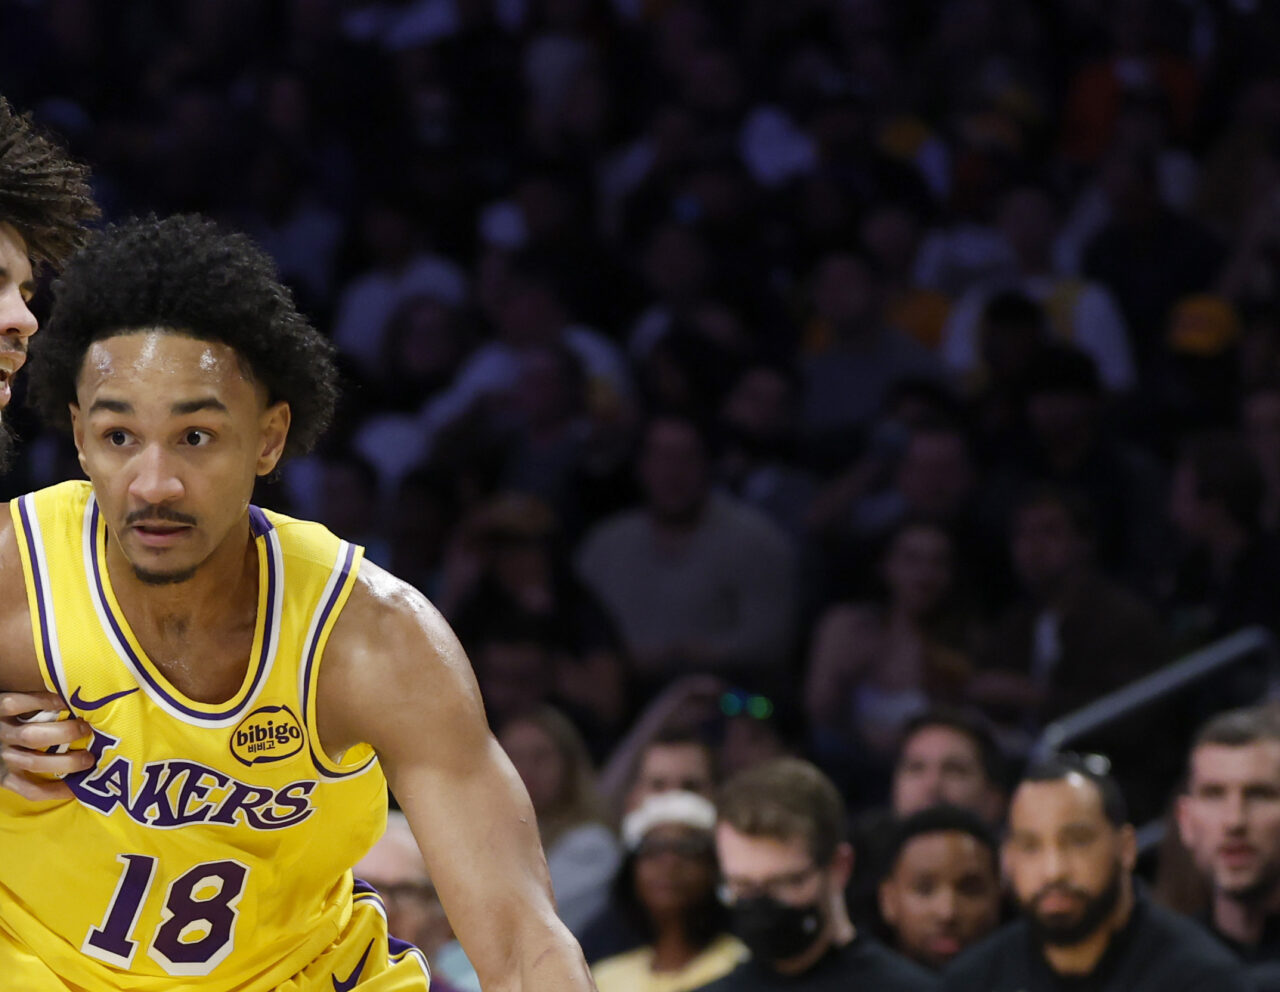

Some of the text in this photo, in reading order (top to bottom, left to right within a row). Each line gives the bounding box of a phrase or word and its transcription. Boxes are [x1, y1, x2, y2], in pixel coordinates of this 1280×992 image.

[237, 720, 300, 747] bibigo
[248, 740, 276, 753] 비비고
[61, 728, 319, 832] LAKERS
[81, 853, 251, 976] 18
